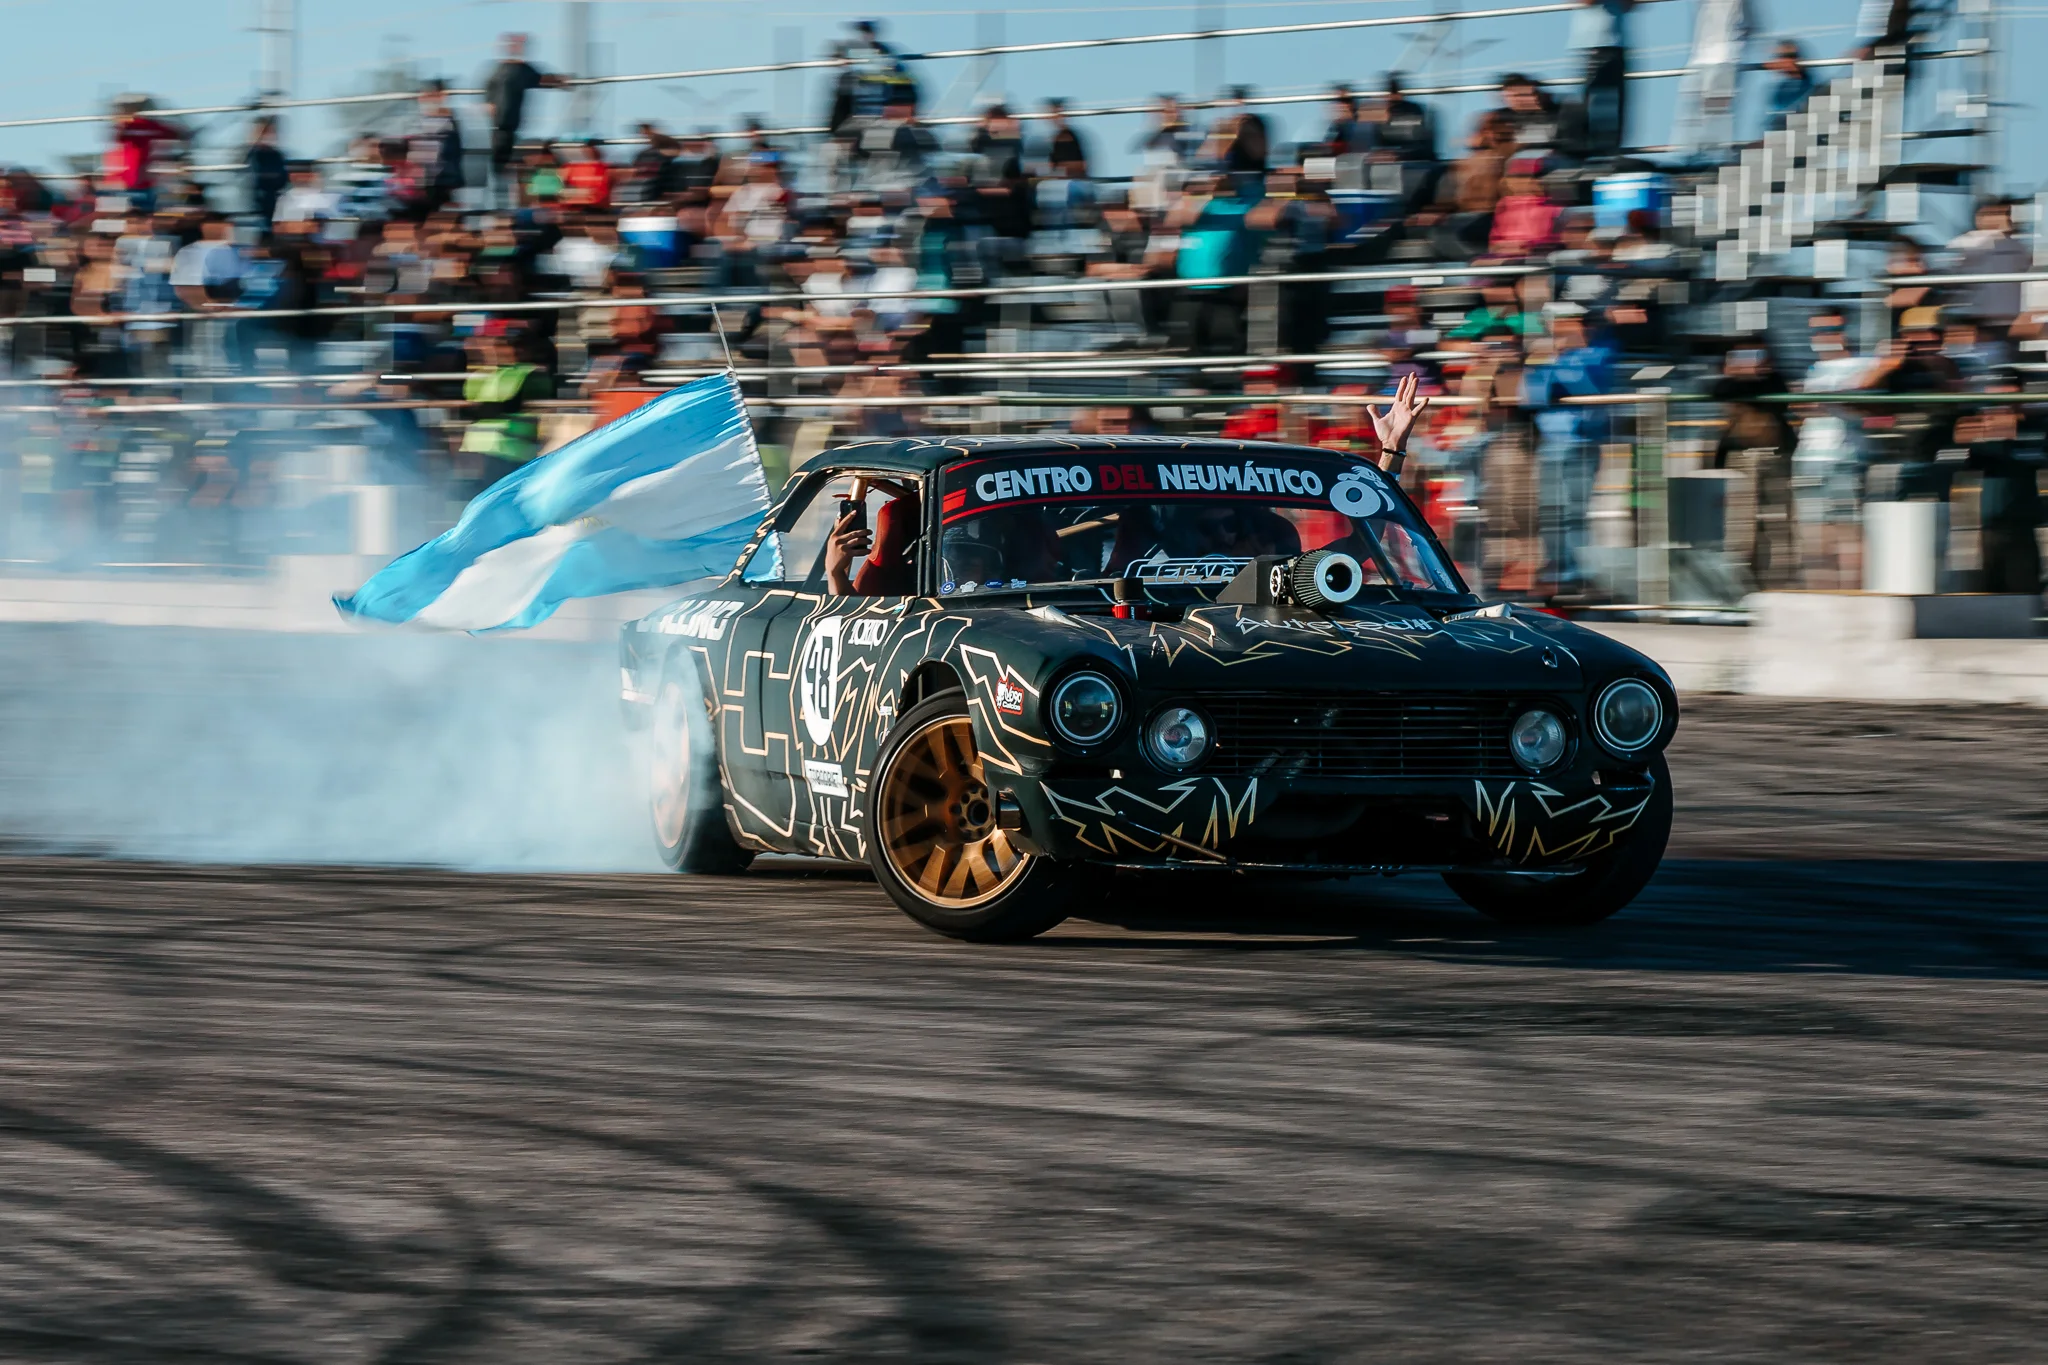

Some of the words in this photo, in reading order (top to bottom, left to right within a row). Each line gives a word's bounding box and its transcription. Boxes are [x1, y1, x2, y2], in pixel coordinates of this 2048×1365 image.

[975, 465, 1092, 501] CENTRO
[1099, 464, 1154, 491] DEL
[1158, 460, 1323, 496] NEUMÁTICO
